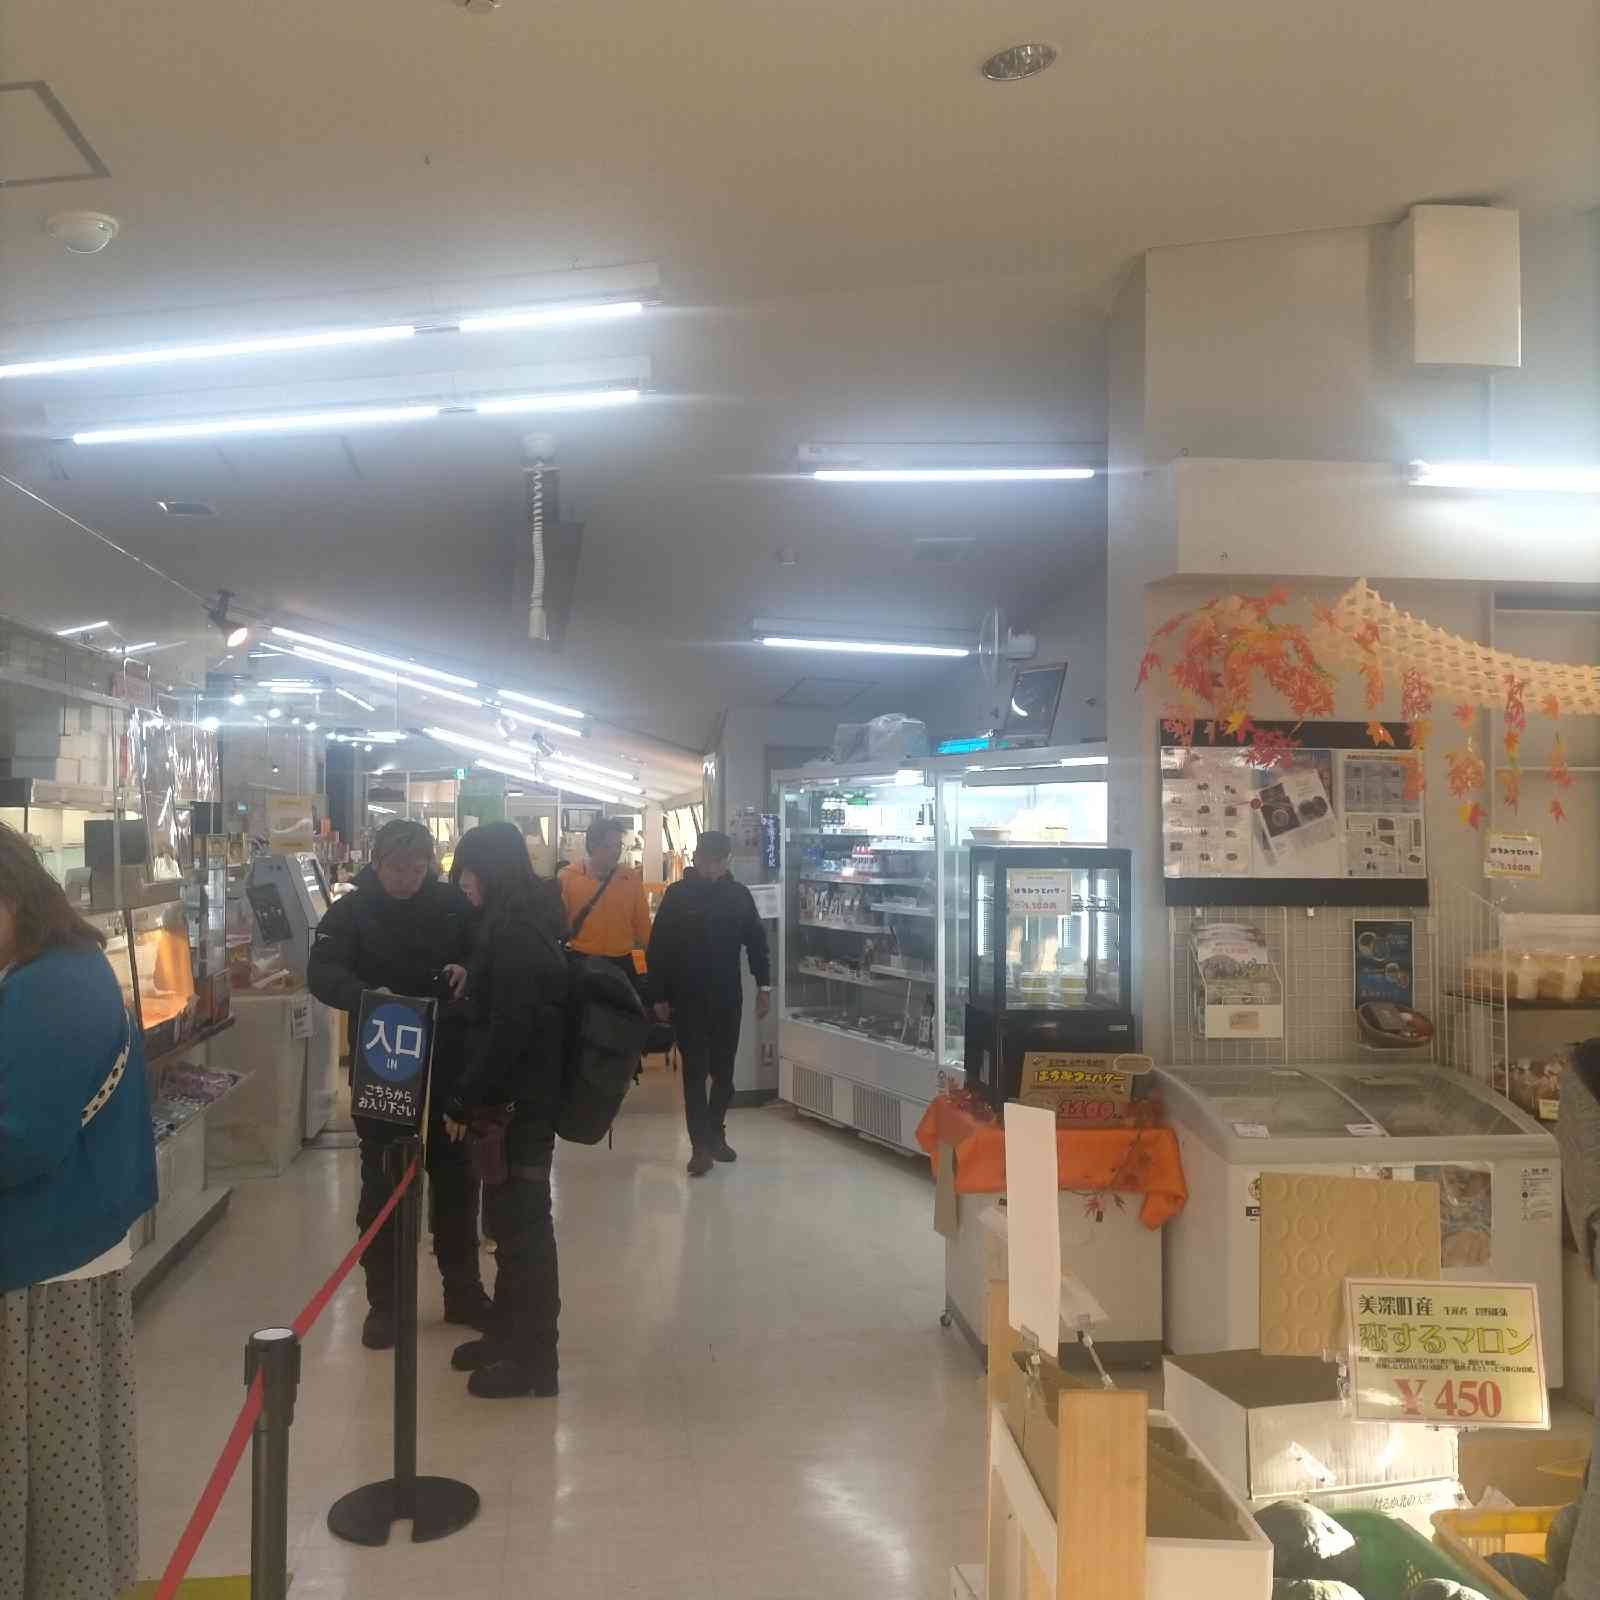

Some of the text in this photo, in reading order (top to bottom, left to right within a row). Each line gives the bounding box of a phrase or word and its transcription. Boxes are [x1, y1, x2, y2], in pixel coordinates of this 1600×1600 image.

[366, 1018, 423, 1059] 入口
[386, 1058, 399, 1071] IN
[364, 1083, 413, 1103] こちらから
[358, 1096, 417, 1118] お入り下さい
[1359, 1295, 1433, 1317] 美深町産
[1357, 1321, 1534, 1356] 恋するマロン
